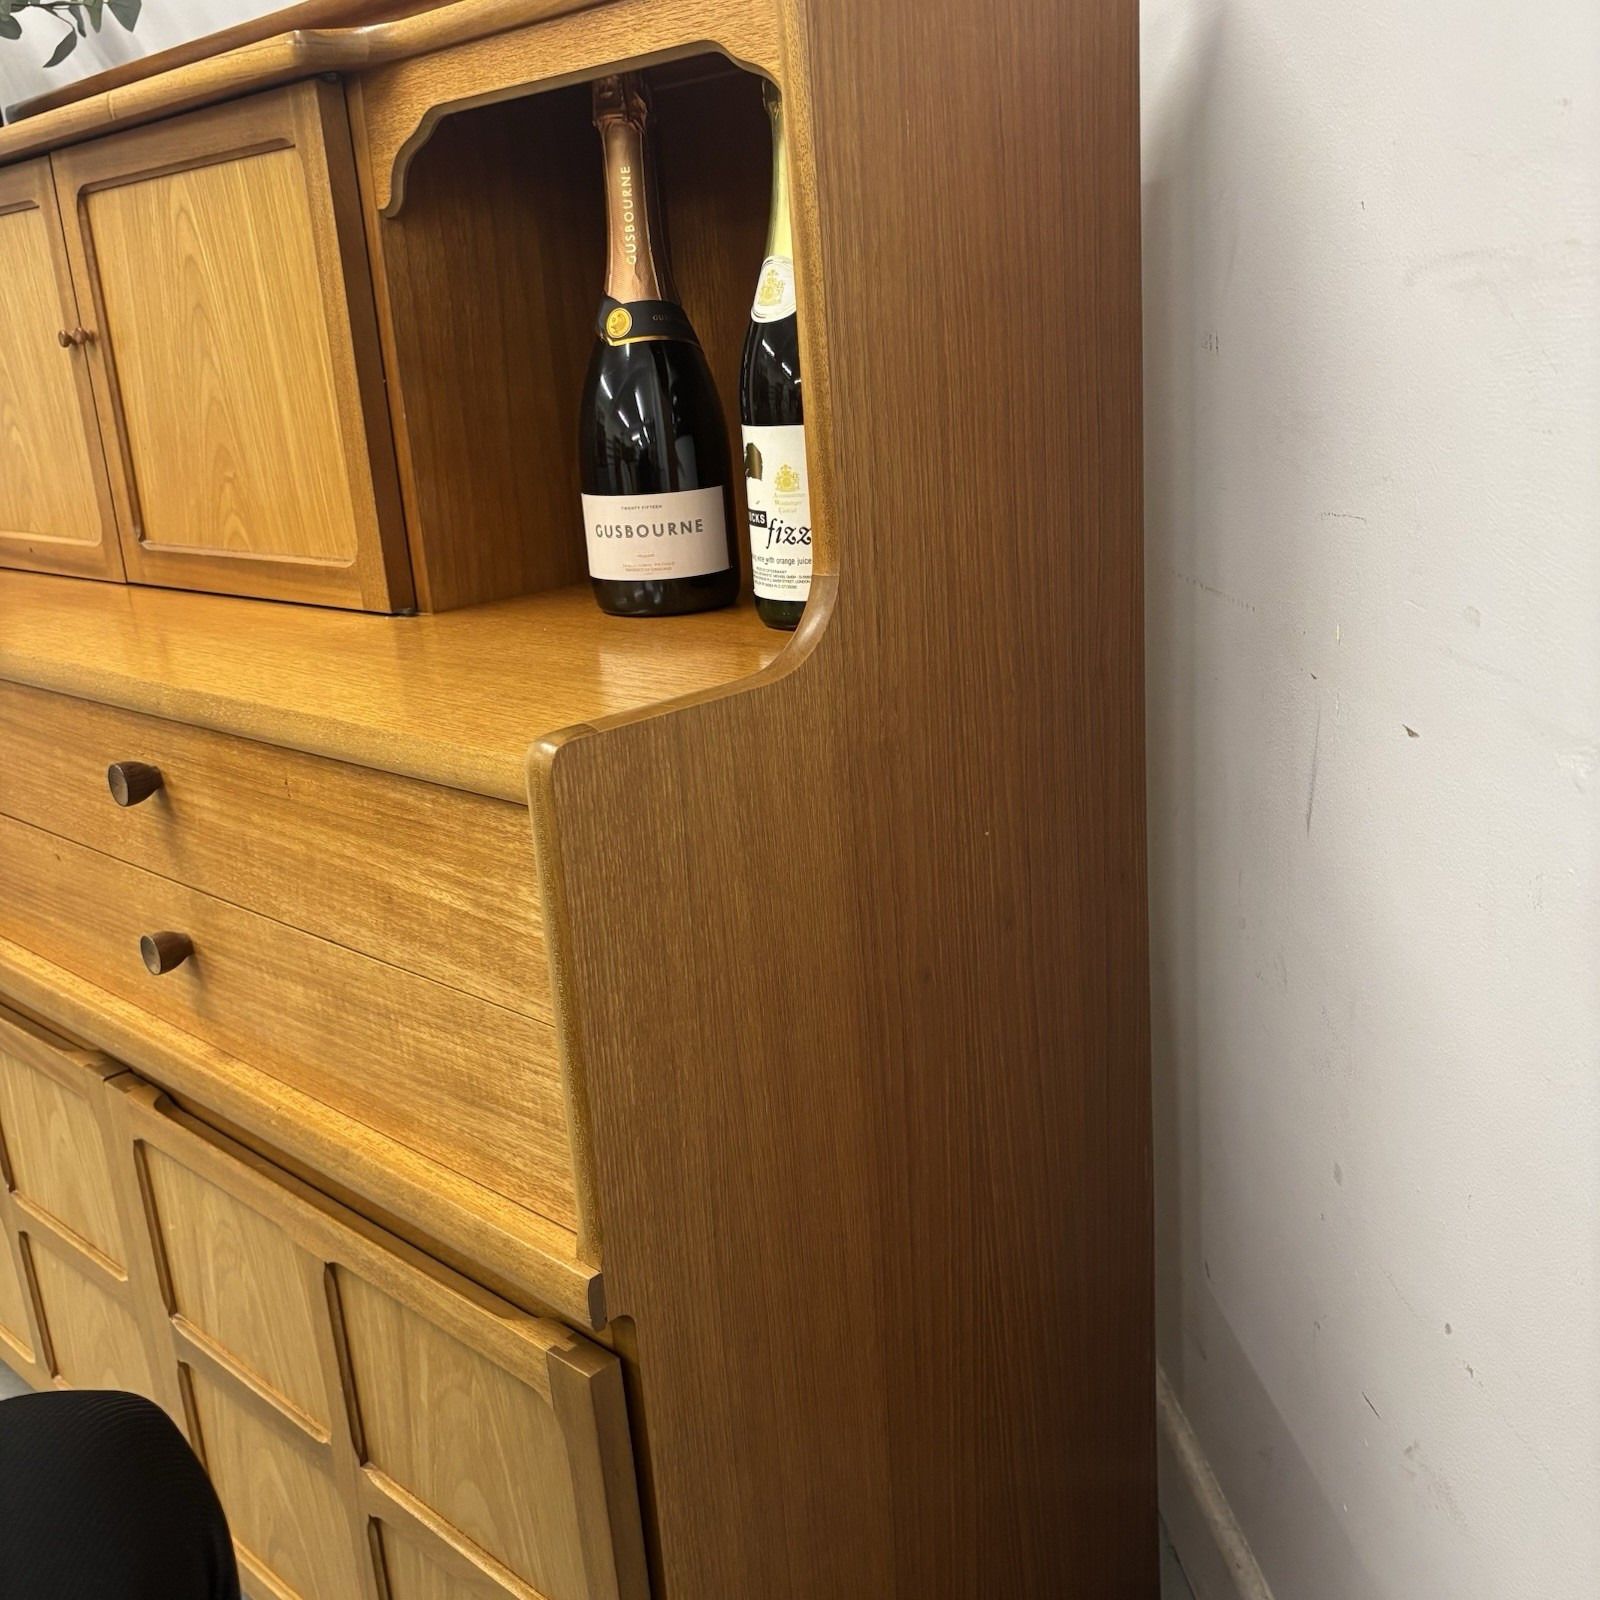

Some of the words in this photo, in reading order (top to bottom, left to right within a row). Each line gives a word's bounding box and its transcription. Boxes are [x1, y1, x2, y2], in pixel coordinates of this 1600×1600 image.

[620, 165, 637, 265] GUSBOURNE
[595, 518, 704, 539] GUSBOURNE
[766, 517, 811, 549] fizz
[776, 557, 796, 566] orange
[797, 556, 811, 566] juice
